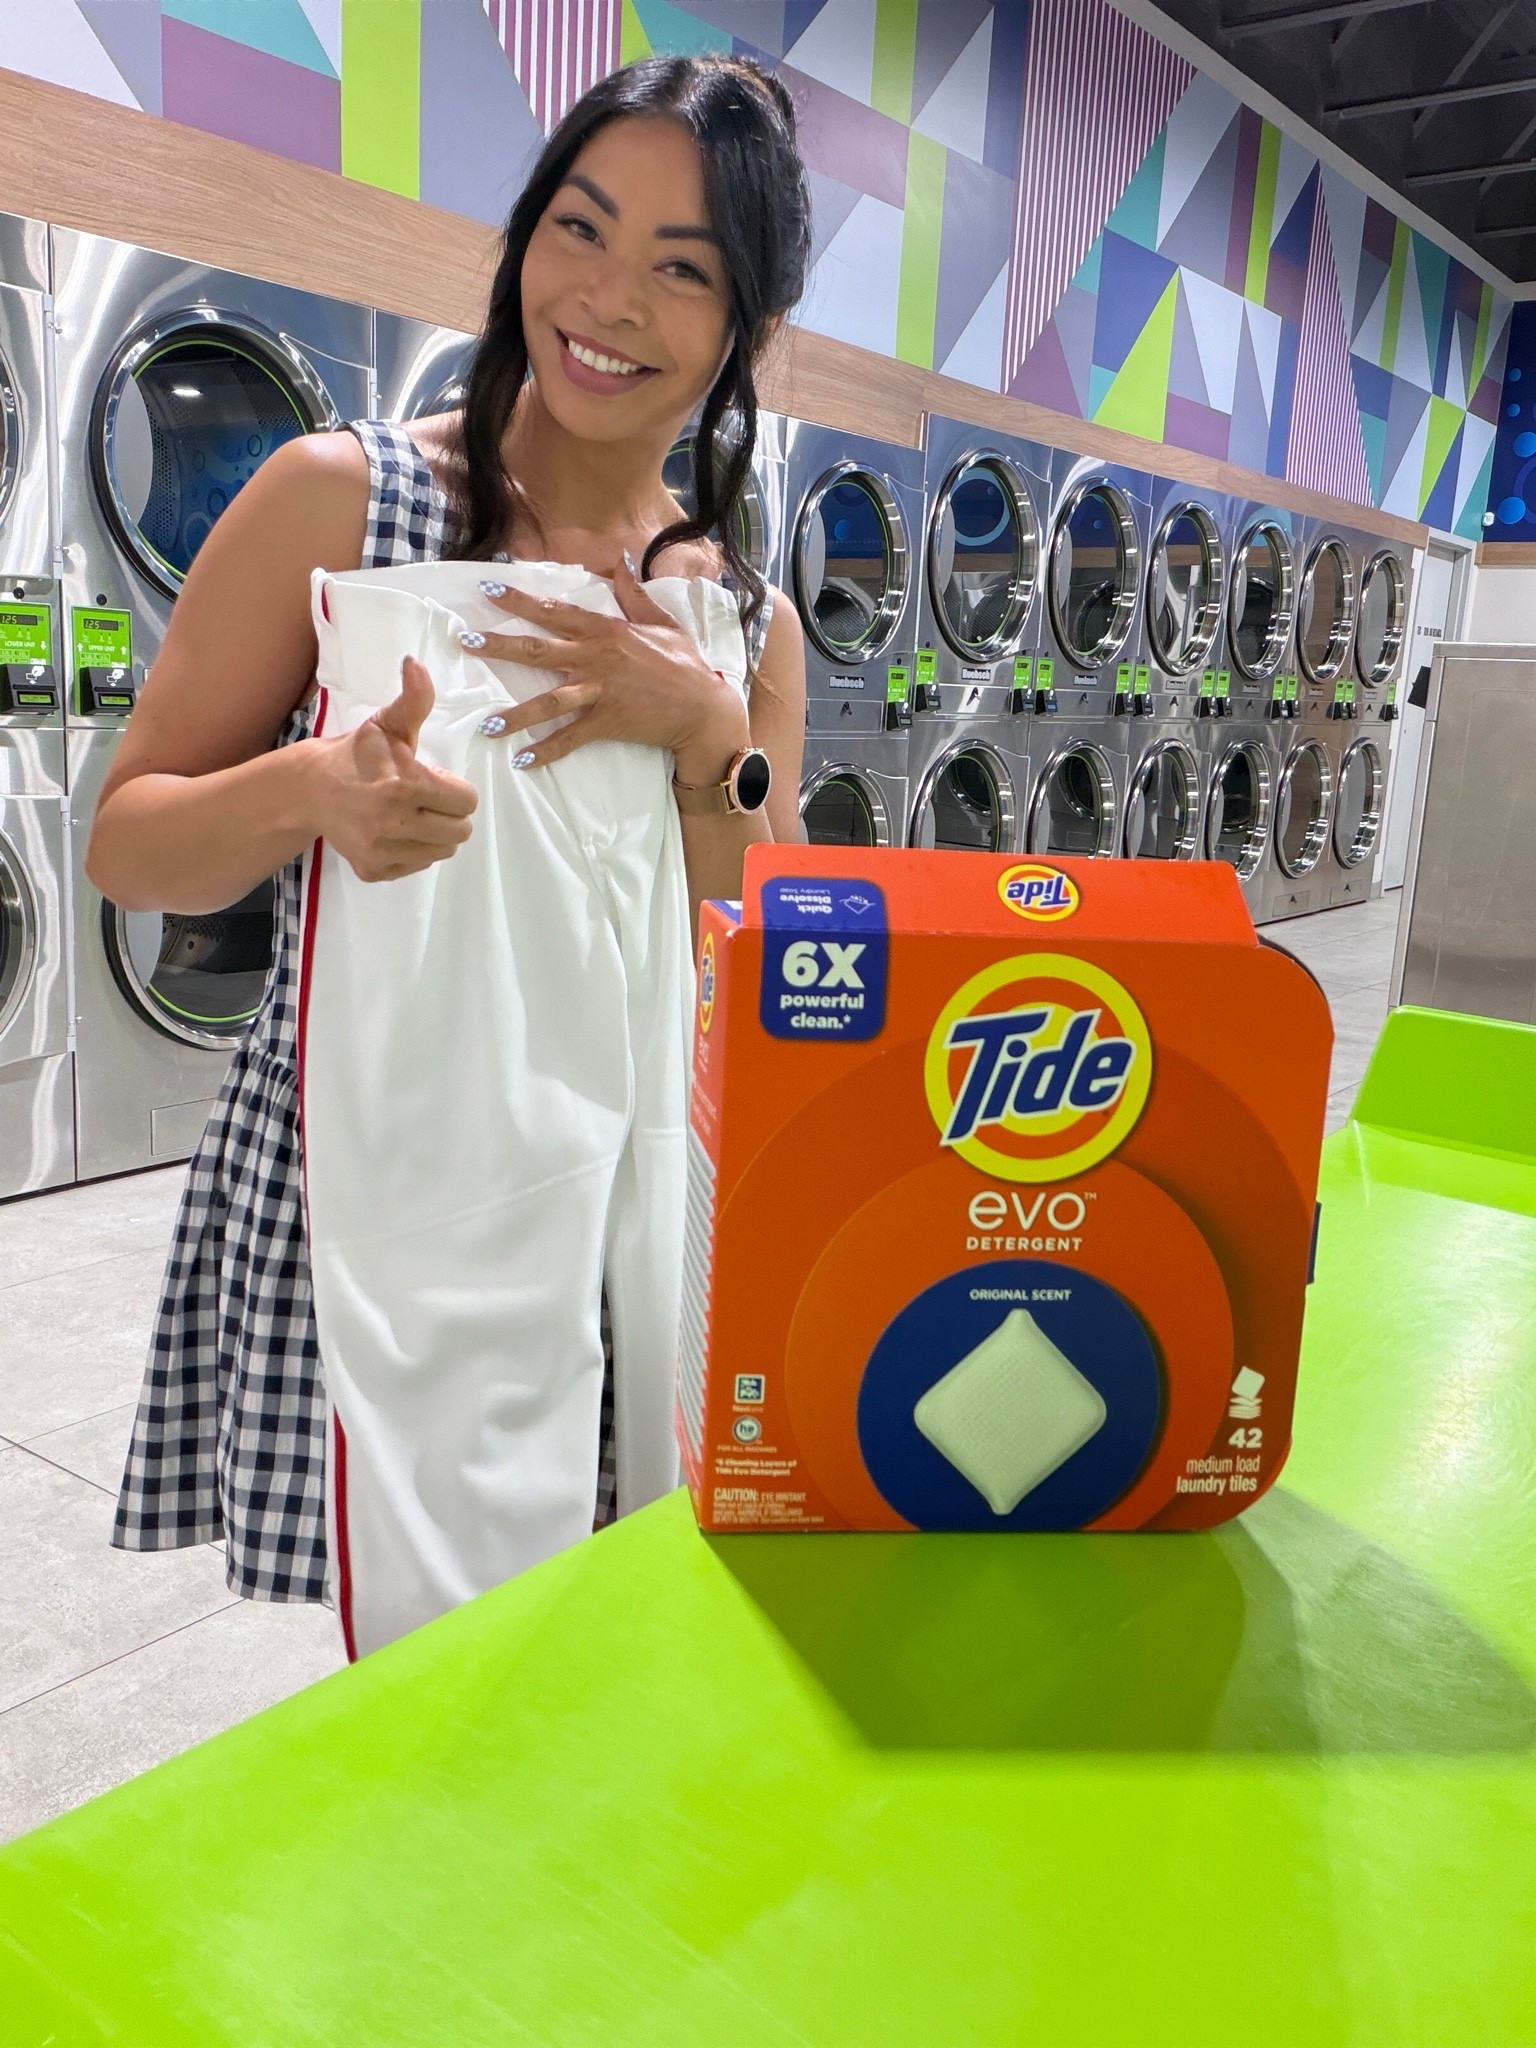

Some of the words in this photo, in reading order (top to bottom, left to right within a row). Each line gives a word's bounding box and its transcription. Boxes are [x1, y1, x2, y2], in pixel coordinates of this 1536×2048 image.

[85, 620, 100, 629] 125
[799, 887, 831, 895] Laundry
[1006, 873, 1071, 908] Tide
[779, 894, 832, 904] Dissolve
[798, 904, 833, 914] Quick
[782, 940, 867, 988] 6X
[779, 993, 865, 1010] powerful
[940, 1005, 1136, 1147] Tide
[966, 1236, 1083, 1251] DETERGENT
[969, 1289, 1029, 1300] ORIGINAL
[1032, 1289, 1072, 1301] SCENT
[1228, 1427, 1263, 1448] 42
[1186, 1455, 1233, 1473] medium
[1236, 1455, 1261, 1472] load
[1176, 1476, 1226, 1495] laundry
[1229, 1475, 1257, 1492] tiles
[714, 1487, 758, 1501] CAUTION:
